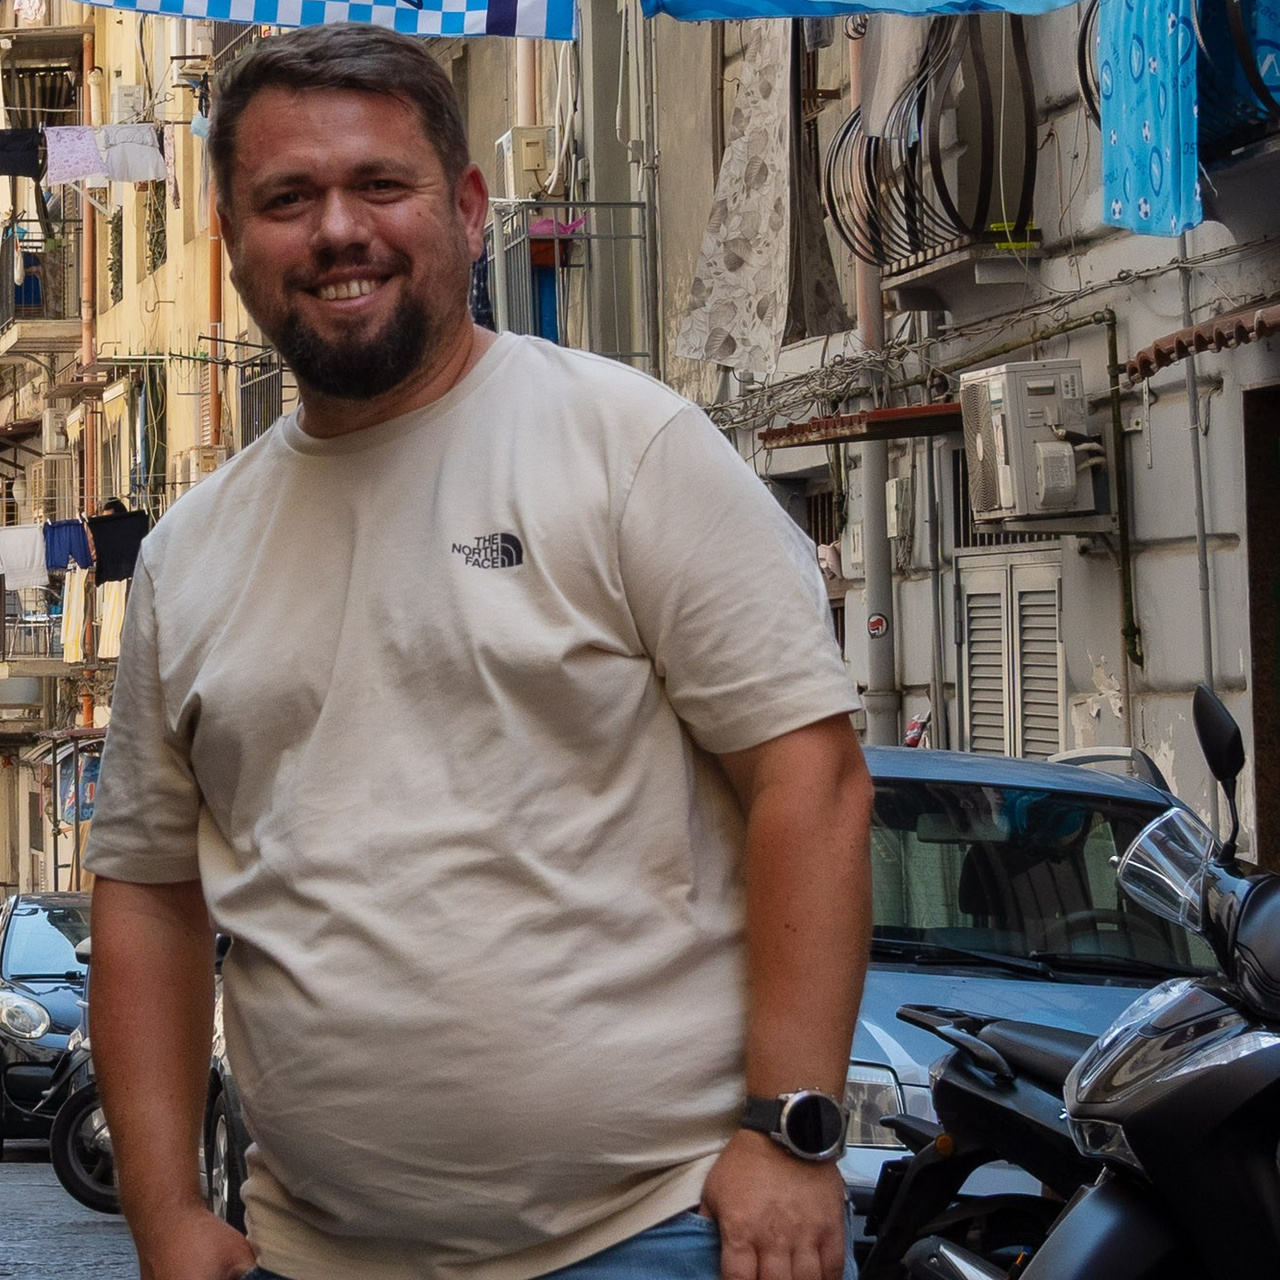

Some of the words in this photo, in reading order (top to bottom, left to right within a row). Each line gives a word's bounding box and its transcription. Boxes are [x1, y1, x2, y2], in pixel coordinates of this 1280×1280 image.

[474, 532, 499, 547] THE
[451, 542, 499, 558] NORTH
[464, 556, 499, 569] FACE
